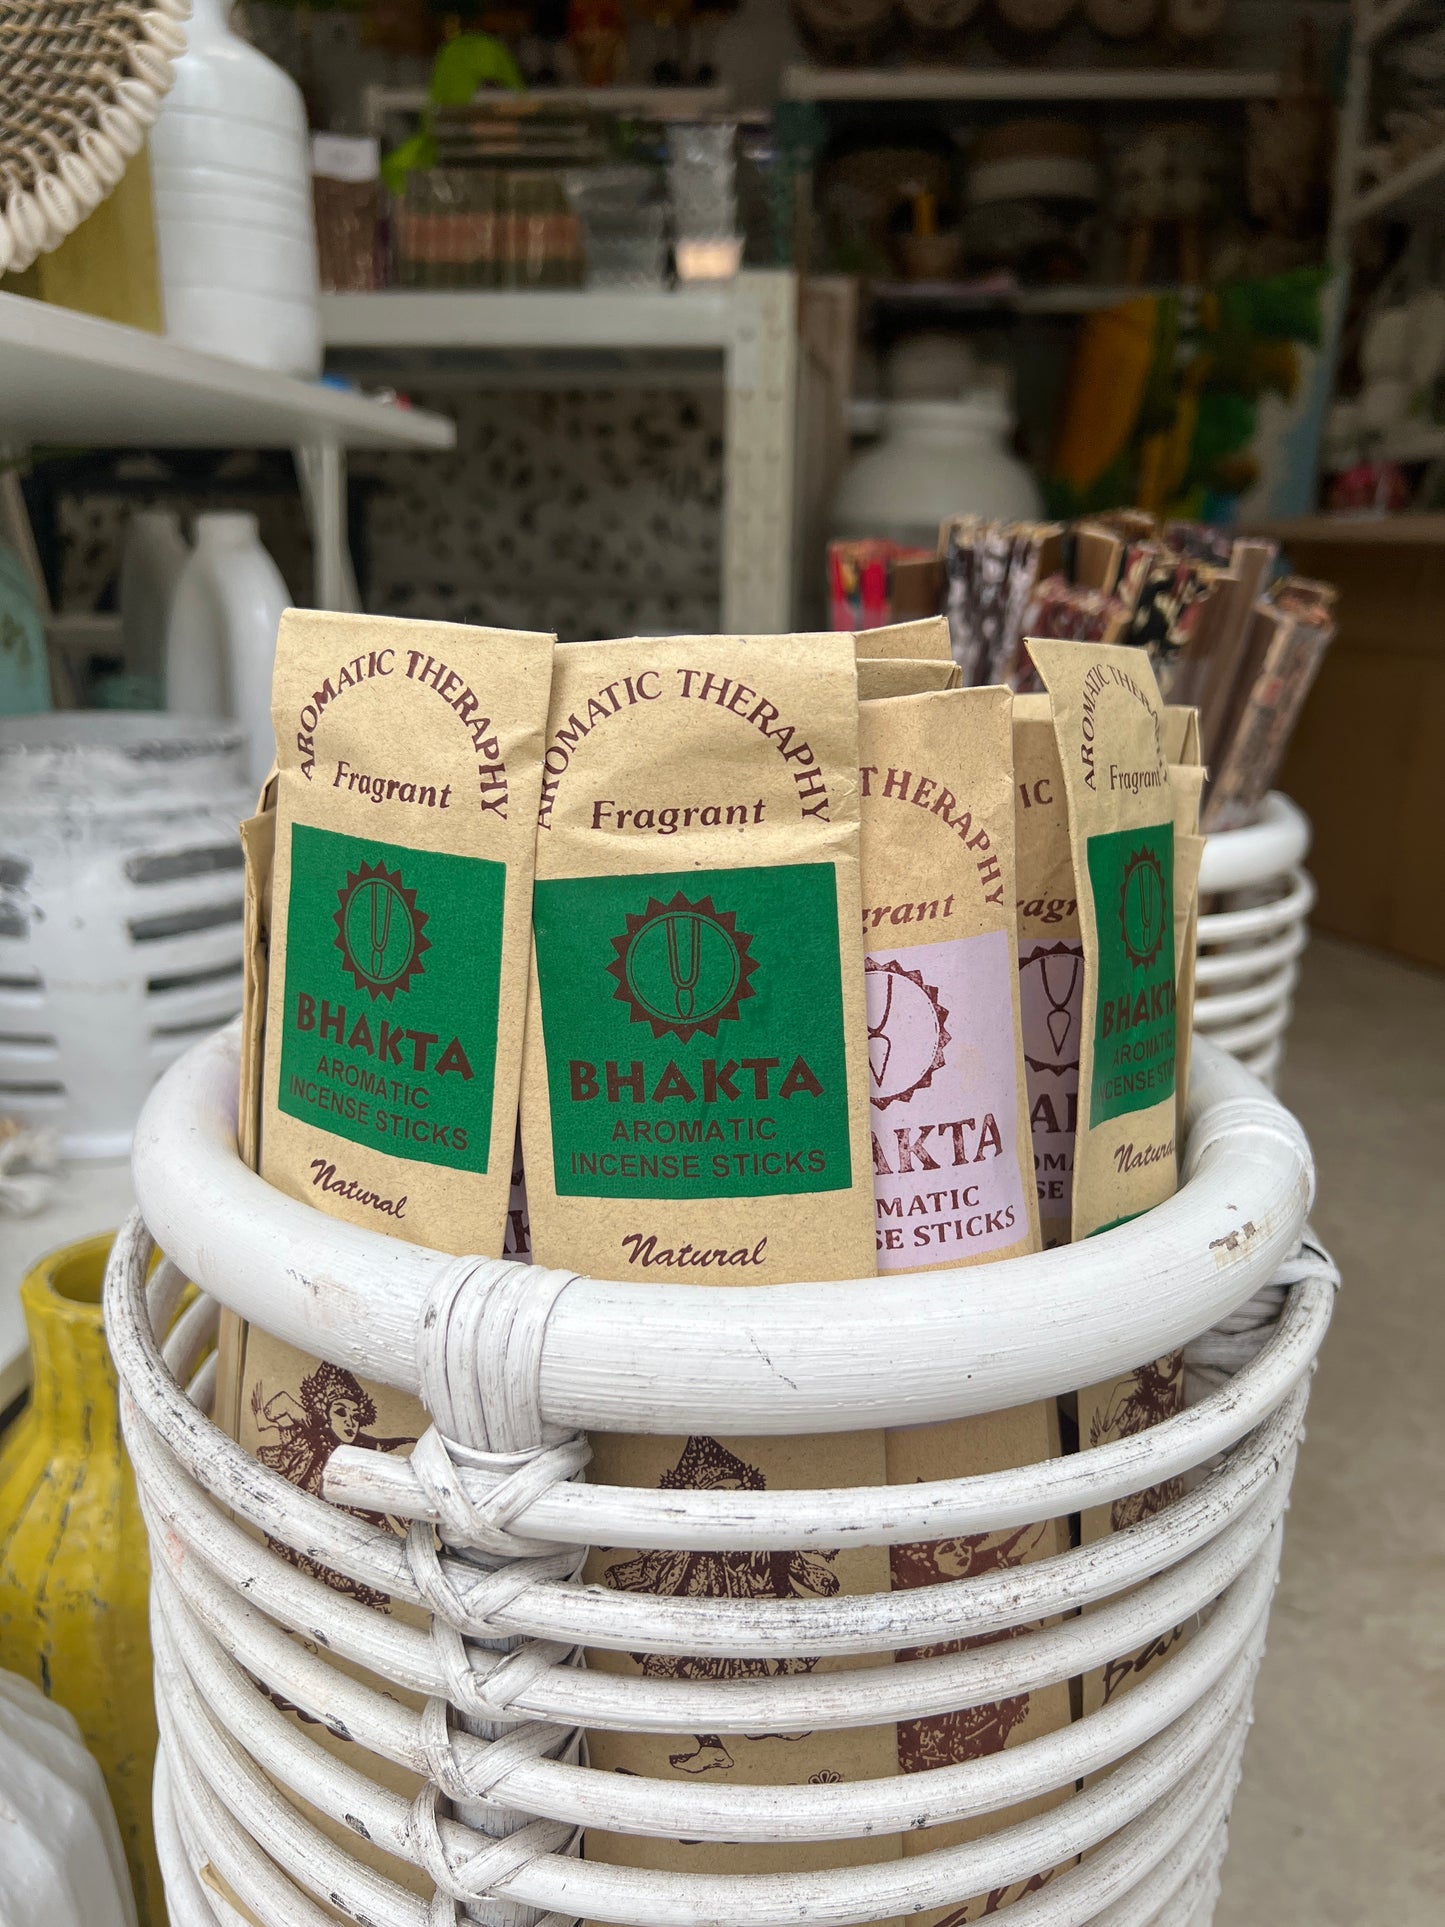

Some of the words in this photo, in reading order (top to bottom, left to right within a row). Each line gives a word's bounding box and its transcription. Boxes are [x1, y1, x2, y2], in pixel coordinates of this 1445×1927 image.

[298, 648, 395, 782] AROMATIC
[405, 650, 508, 820] THERAPHY
[538, 671, 662, 830] AROMATIC
[677, 669, 830, 823] THERAPHY
[1080, 663, 1111, 792] AROMATIC
[333, 761, 452, 808] Fragrant
[1109, 764, 1162, 795] Fragrant
[591, 799, 765, 835] Fragrant
[859, 766, 1004, 906] THERAPHY
[297, 991, 475, 1081] BHAKTA
[316, 1055, 429, 1109] AROMATIC
[569, 1054, 825, 1103] BHAKTA
[289, 1074, 370, 1125] INCENSE
[375, 1110, 468, 1151] STICKS
[611, 1117, 777, 1144] AROMATIC
[572, 1152, 699, 1179] INCENSE
[712, 1150, 826, 1178] STICKS
[871, 1113, 1003, 1176] AKTA
[1113, 1140, 1175, 1173] Natura
[310, 1158, 408, 1219] Natural
[876, 1185, 980, 1219] MATIC
[622, 1233, 768, 1267] Natural
[914, 1204, 1015, 1247] STICKS
